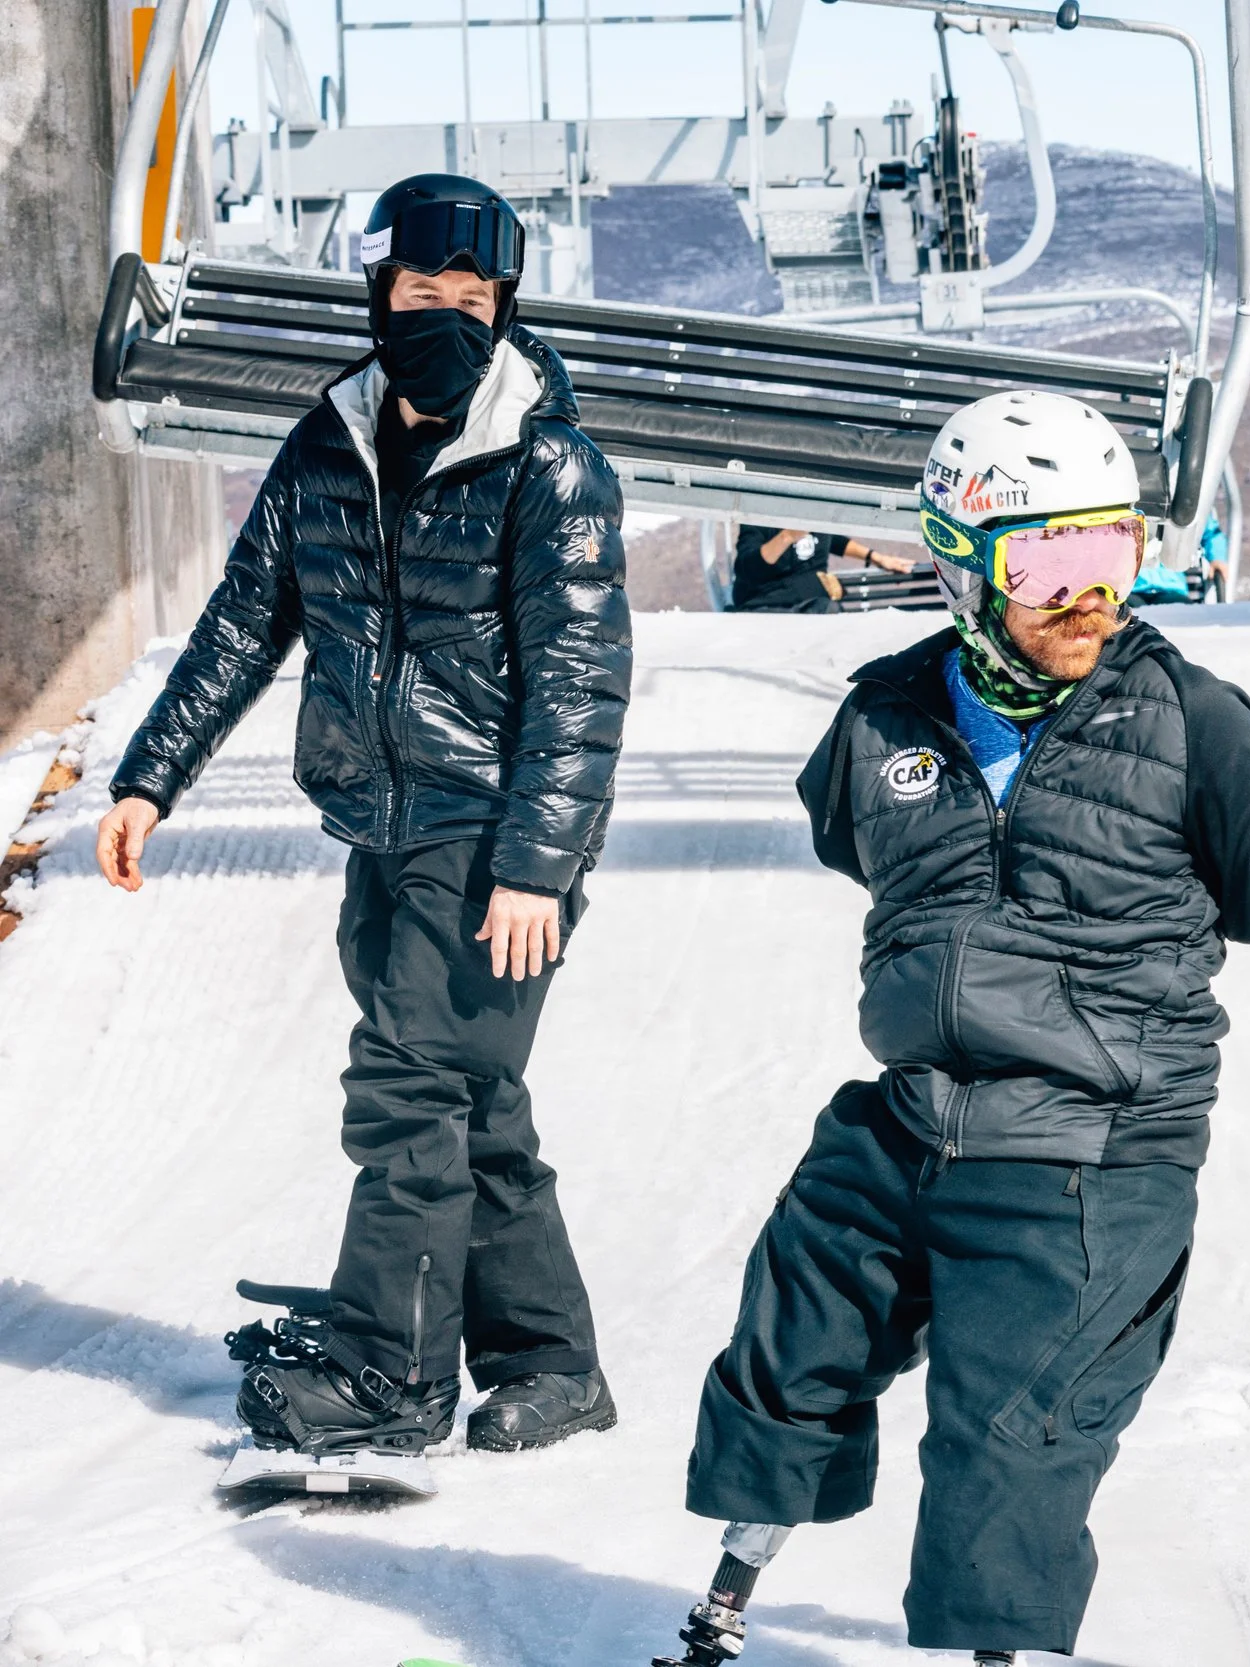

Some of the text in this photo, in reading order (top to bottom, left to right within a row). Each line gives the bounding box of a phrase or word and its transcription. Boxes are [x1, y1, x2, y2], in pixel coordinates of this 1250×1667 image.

[926, 457, 963, 488] pret
[961, 489, 1029, 513] PARK CITY
[879, 746, 948, 777] CHALLENGED ATHLETES
[893, 762, 933, 785] CAF
